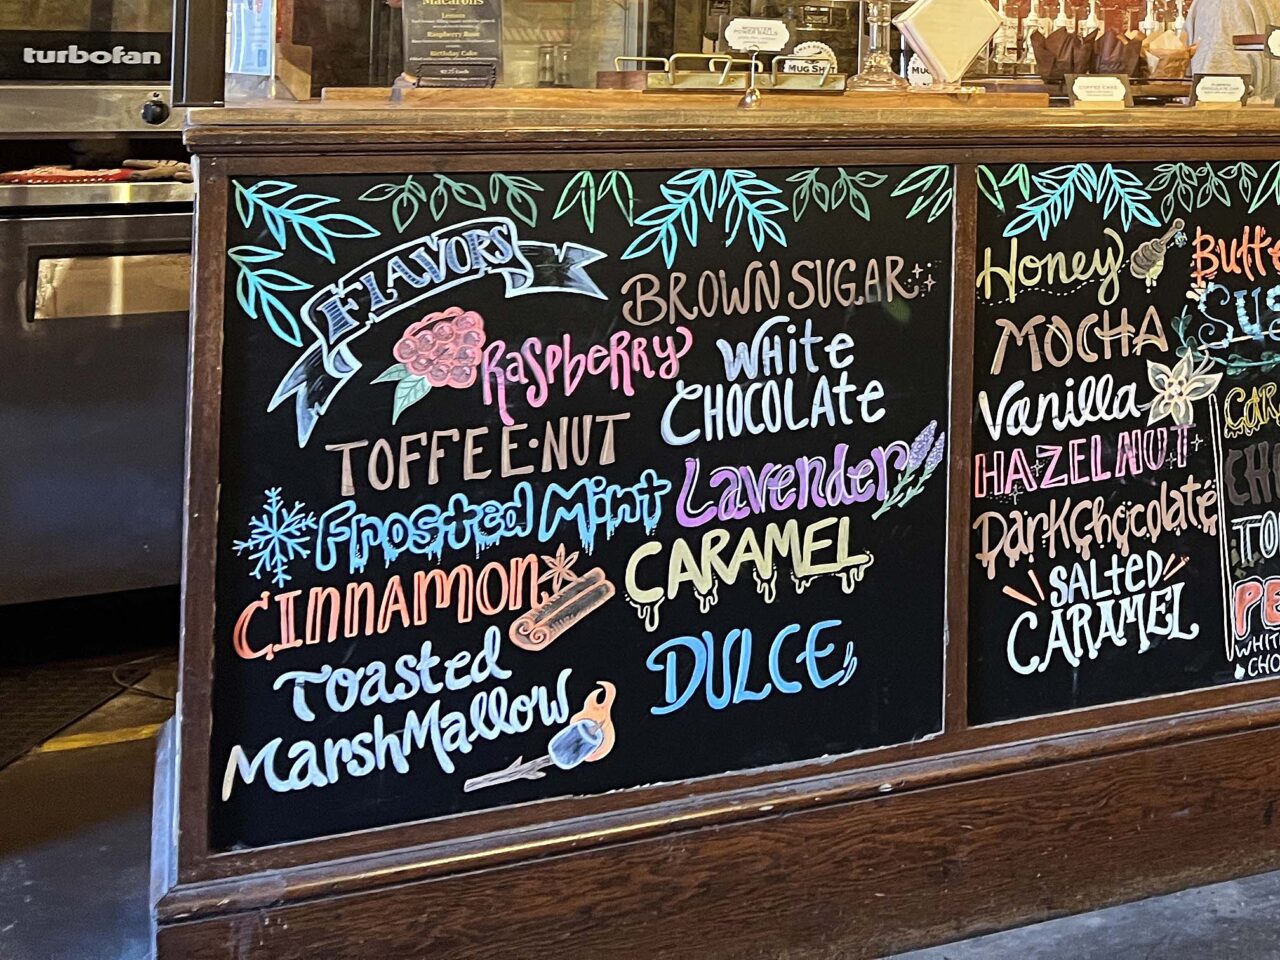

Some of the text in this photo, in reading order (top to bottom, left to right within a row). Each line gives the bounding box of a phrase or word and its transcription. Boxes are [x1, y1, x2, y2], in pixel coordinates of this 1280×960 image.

[23, 45, 161, 65] turbofan
[788, 64, 835, 74] MUG SHT
[316, 224, 514, 341] FLAVORS
[621, 254, 920, 327] BROWN SUGAR
[976, 228, 1126, 305] Honey
[990, 305, 1169, 375] MOCHA
[978, 372, 1150, 440] Vanilla
[676, 440, 910, 528] Lavender
[974, 423, 1197, 498] HAZELNUT
[315, 468, 673, 574] Frosted Mint
[625, 516, 875, 622] CARAMEL
[646, 619, 845, 716] DULCE
[1006, 582, 1200, 675] CARAMEL
[273, 625, 513, 722] Toasted
